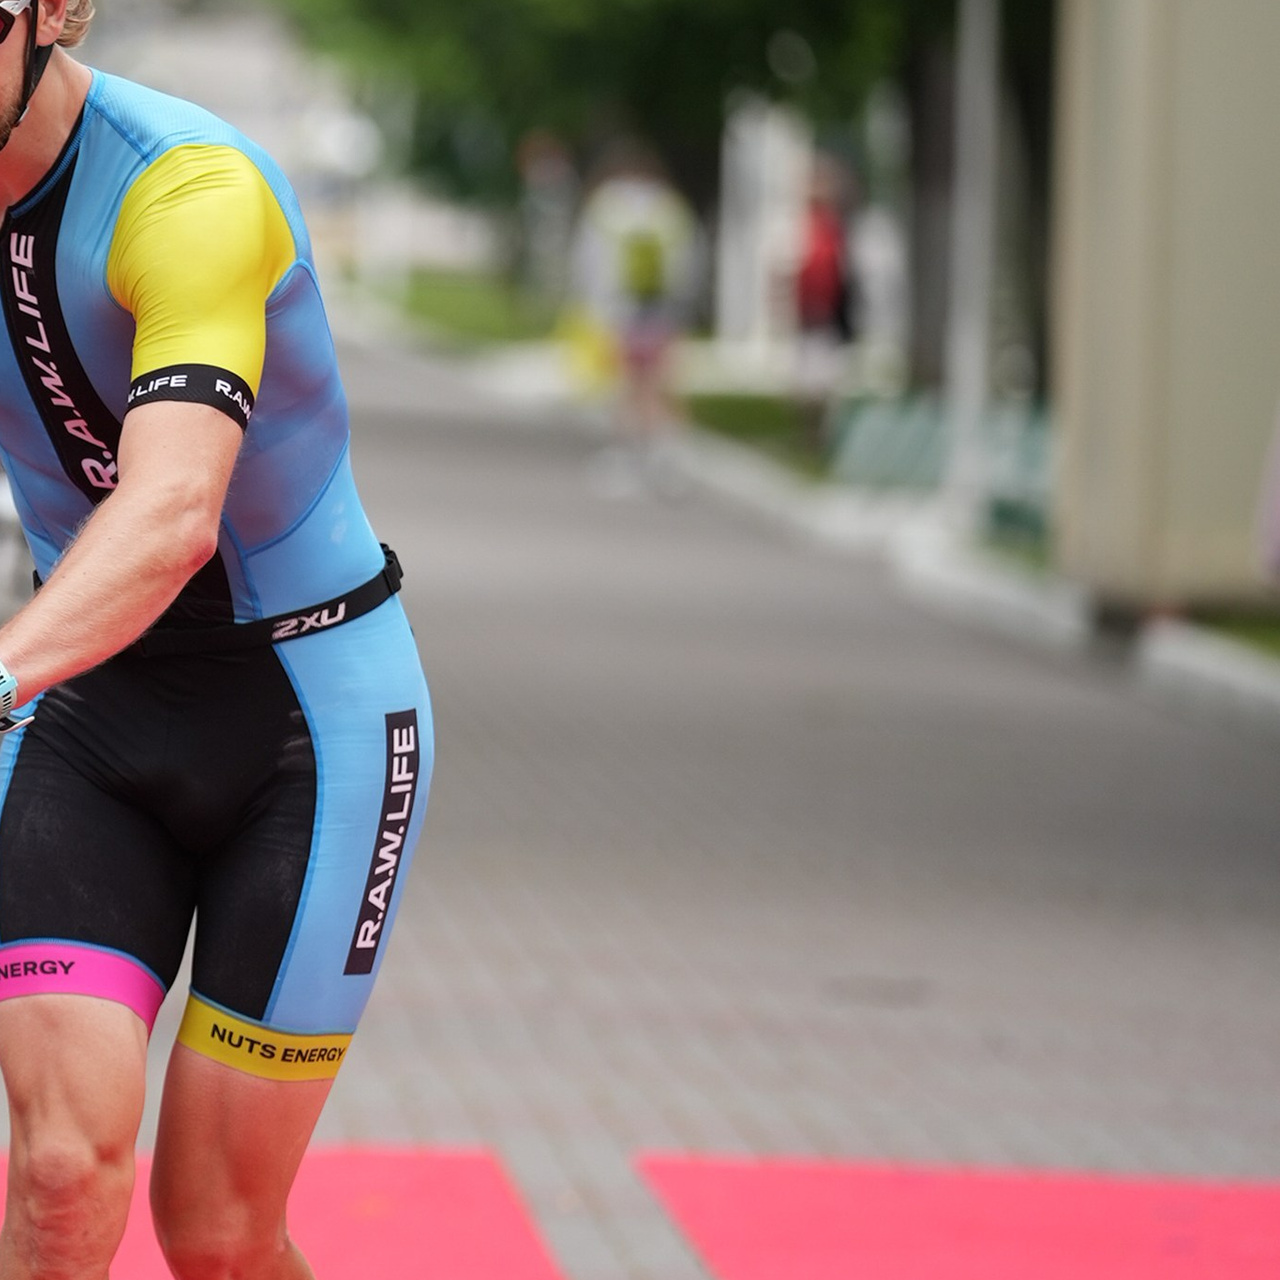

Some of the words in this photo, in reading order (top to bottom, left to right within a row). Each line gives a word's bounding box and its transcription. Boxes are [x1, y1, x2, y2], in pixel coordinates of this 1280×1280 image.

[272, 601, 346, 639] 2XU
[211, 1023, 277, 1060] NUTS
[280, 1047, 346, 1063] ENERGY
